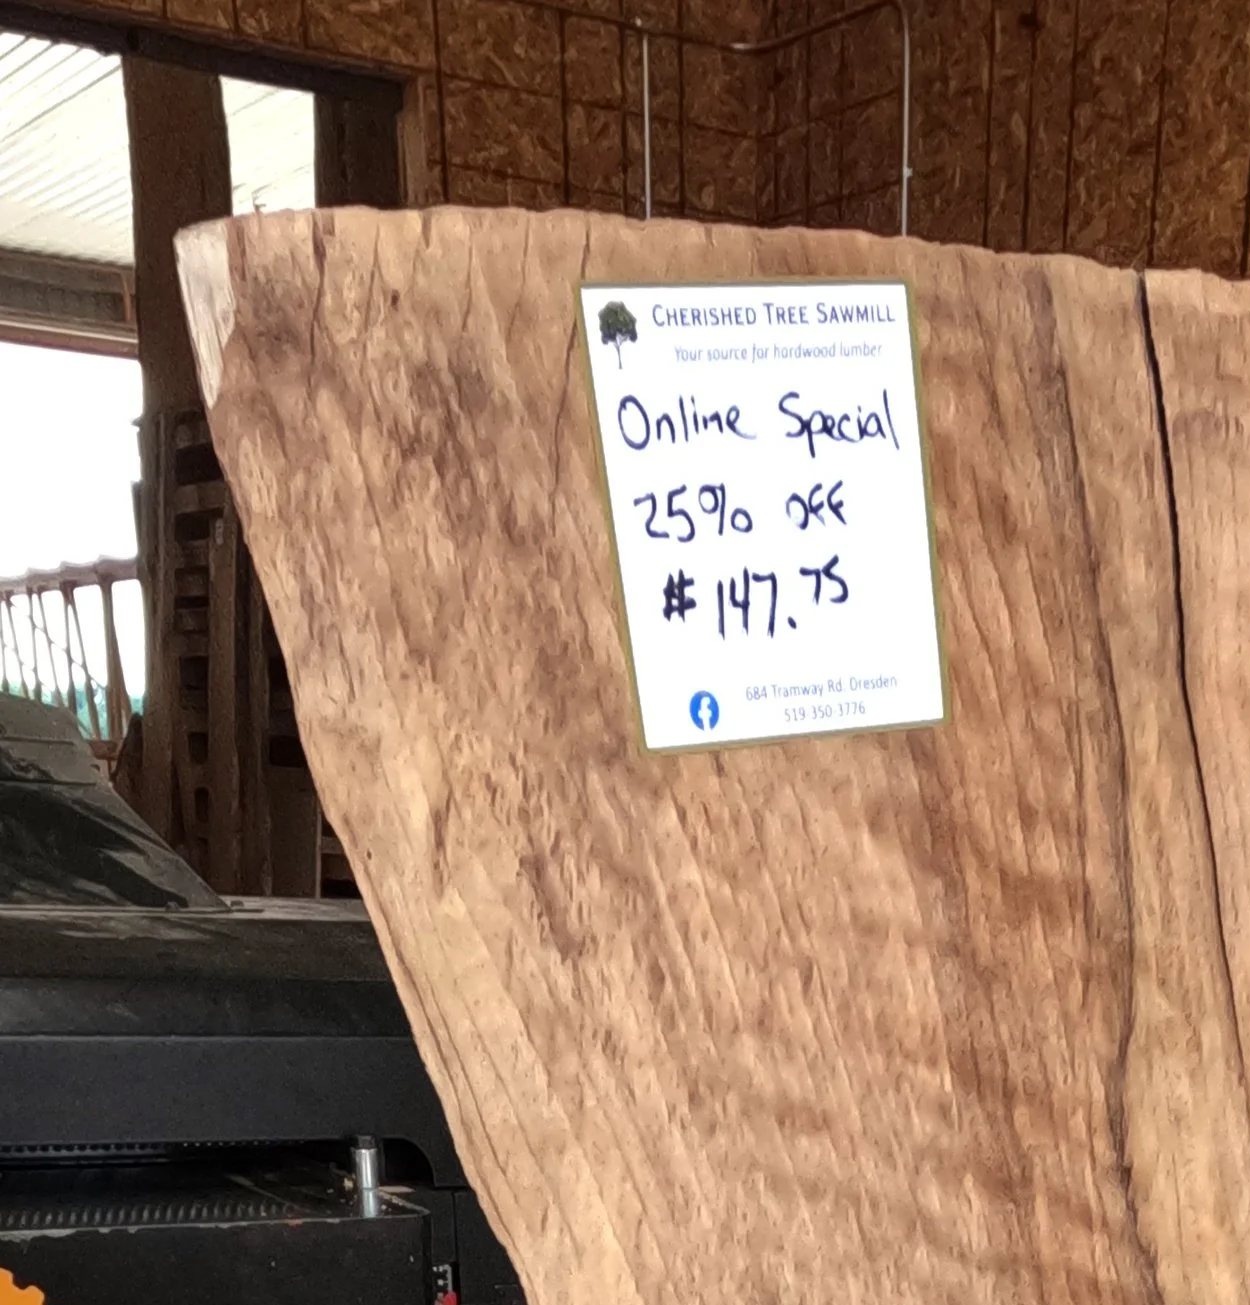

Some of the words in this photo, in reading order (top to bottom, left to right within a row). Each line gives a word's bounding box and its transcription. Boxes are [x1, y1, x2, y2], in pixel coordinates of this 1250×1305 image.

[652, 303, 757, 327] CHERISHED
[762, 302, 810, 325] TREE
[816, 301, 897, 324] SAWMILL
[674, 345, 703, 362] Your
[707, 348, 748, 361] source
[752, 343, 769, 364] for
[773, 343, 836, 360] hardwood
[840, 341, 883, 358] lumber
[617, 394, 758, 451] Online
[778, 388, 900, 459] Special
[633, 482, 754, 543] 25%
[745, 685, 768, 702] 684
[770, 682, 824, 699] Tramway
[849, 673, 898, 692] Dresden
